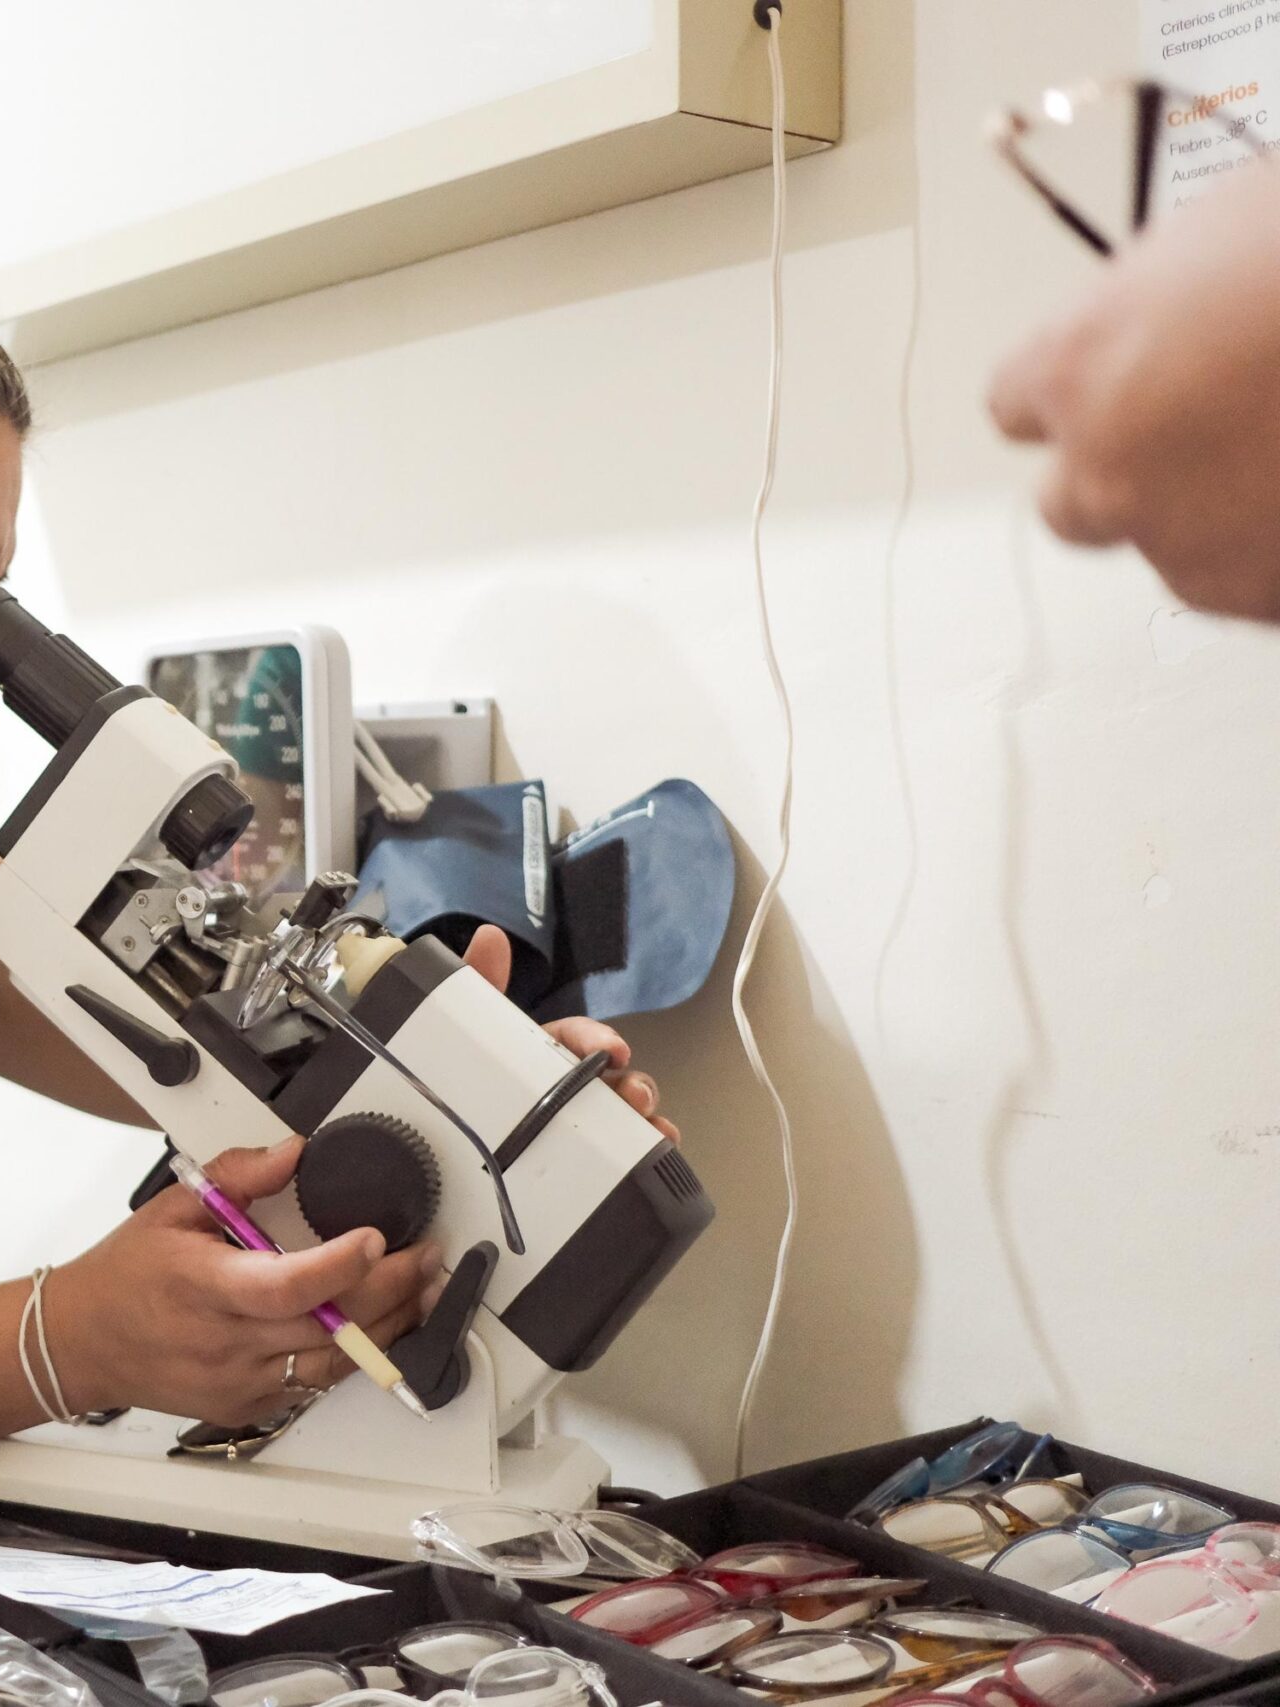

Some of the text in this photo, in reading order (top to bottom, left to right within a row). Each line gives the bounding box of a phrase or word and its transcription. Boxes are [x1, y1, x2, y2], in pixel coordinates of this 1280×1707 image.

[1160, 11, 1215, 36] Criterios
[1162, 22, 1251, 60] (Estreptococo
[1167, 81, 1259, 127] Criterios
[1169, 136, 1212, 156] Fiebre
[1171, 157, 1234, 183] Ausencia
